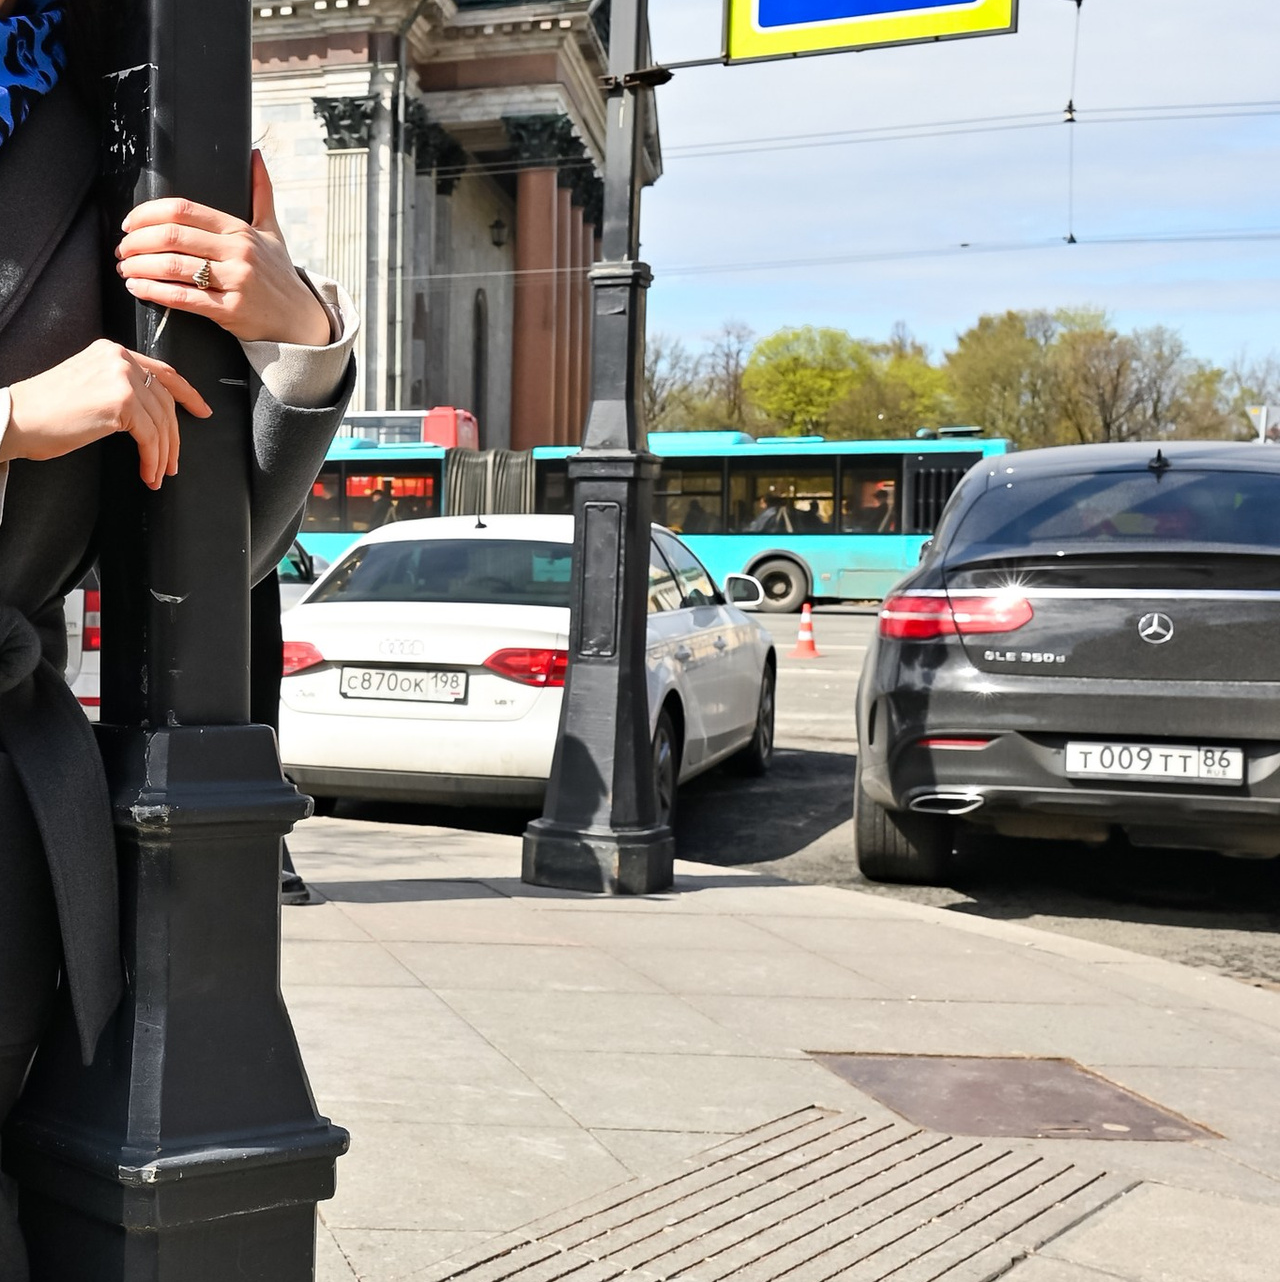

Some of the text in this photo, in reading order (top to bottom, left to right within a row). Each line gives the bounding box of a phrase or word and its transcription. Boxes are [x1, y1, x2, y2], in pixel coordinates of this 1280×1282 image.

[347, 672, 459, 693] С870ОК 198
[1203, 749, 1231, 768] 86
